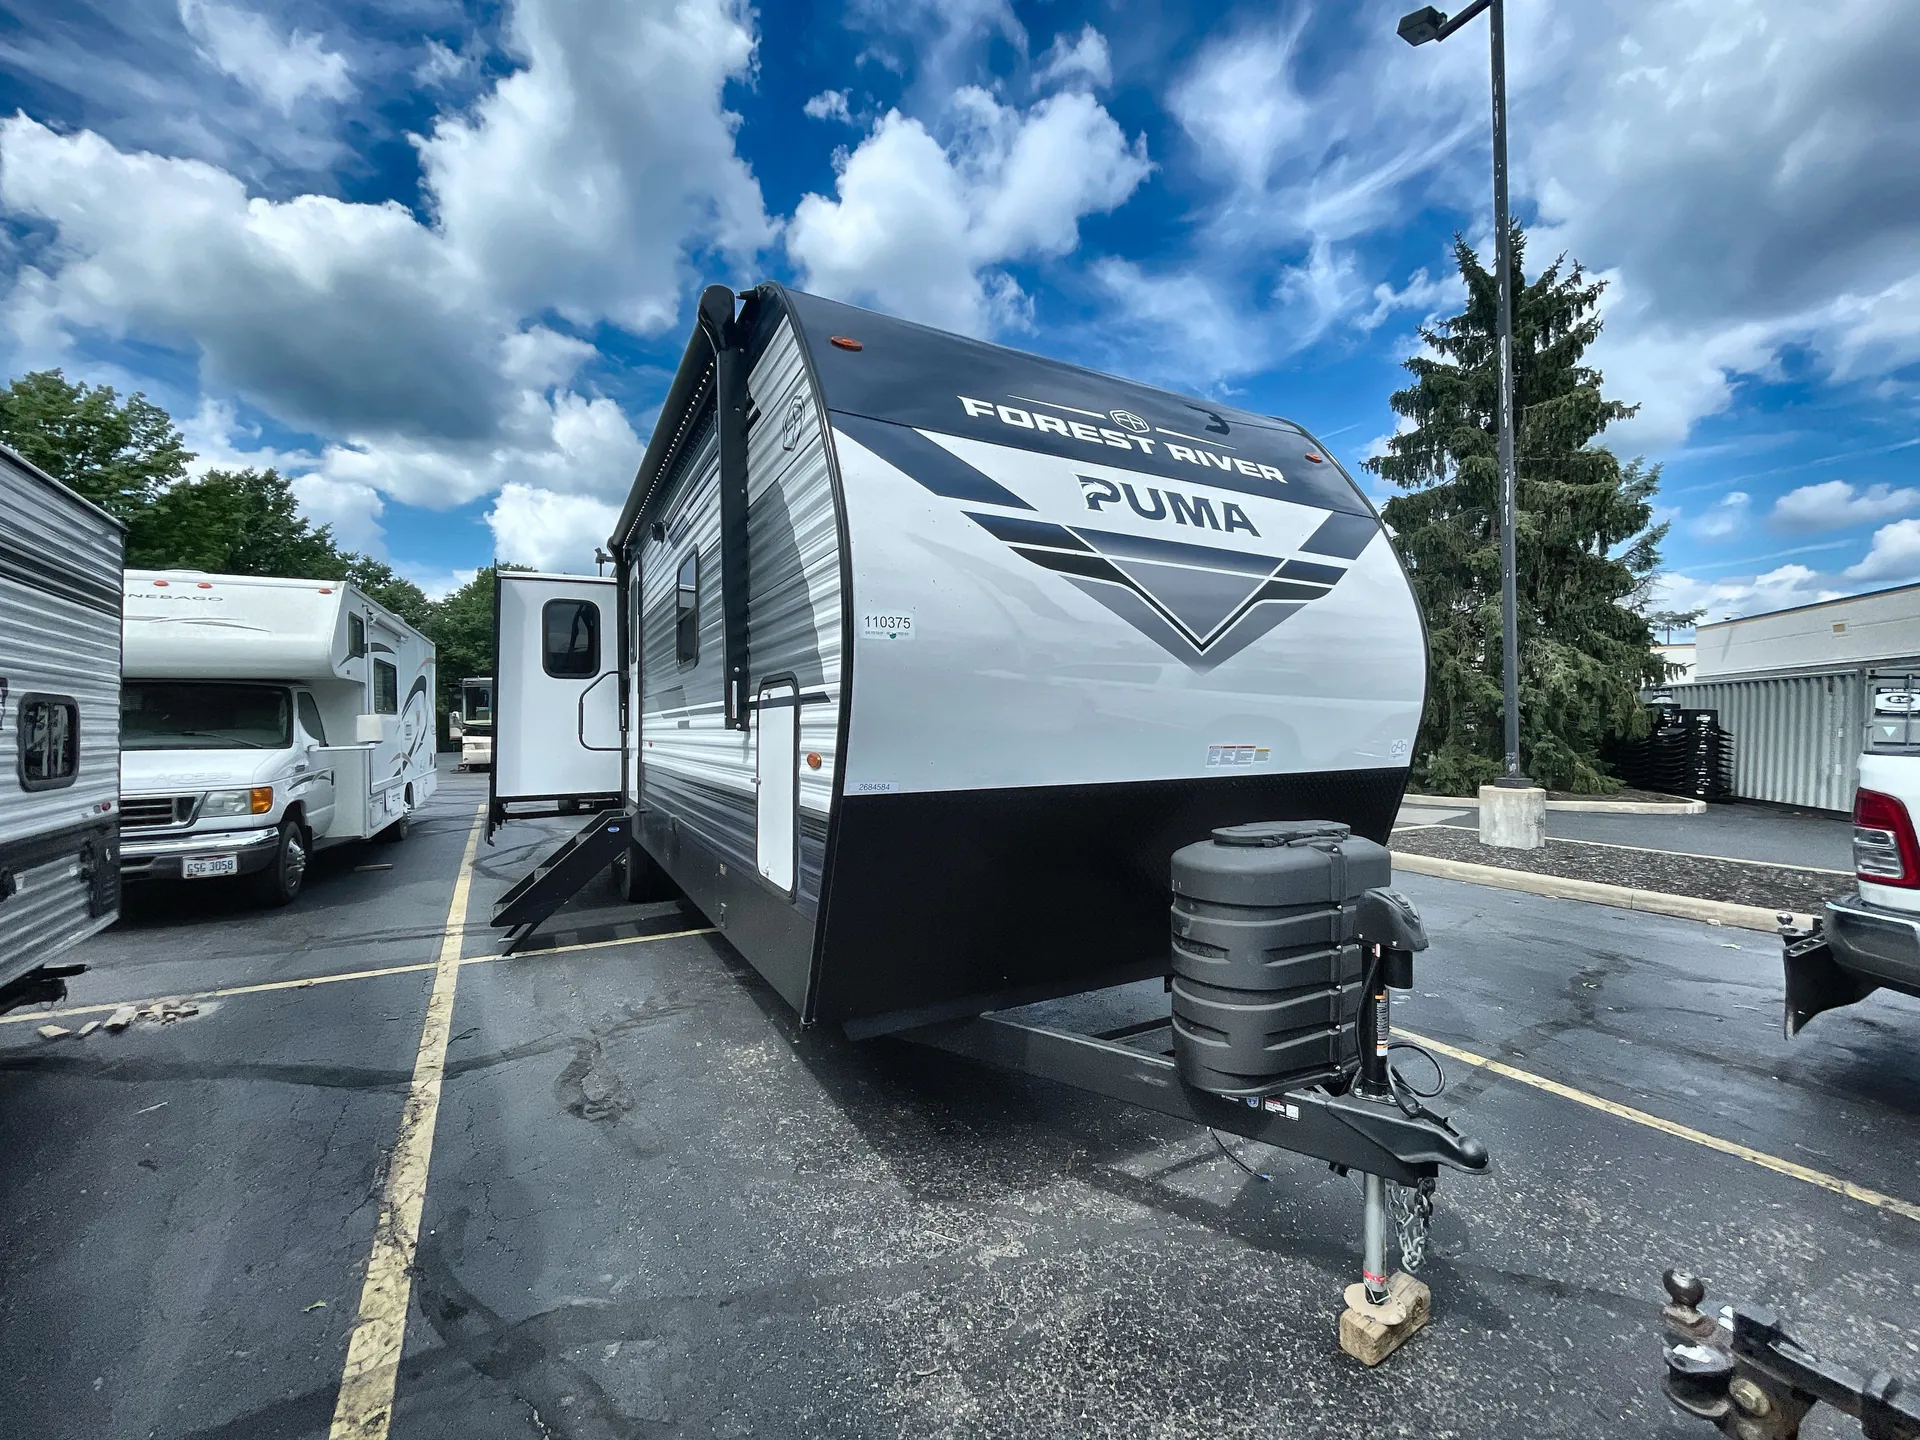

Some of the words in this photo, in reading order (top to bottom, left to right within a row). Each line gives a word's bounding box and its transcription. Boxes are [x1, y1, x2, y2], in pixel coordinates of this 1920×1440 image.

[957, 395, 1156, 455] FOREST
[1163, 442, 1288, 484] RIVER
[1074, 473, 1262, 538] PUMA
[124, 593, 223, 602] NEBAGO
[864, 615, 911, 629] 110375
[858, 783, 890, 791] 2684584
[210, 860, 233, 872] 3058
